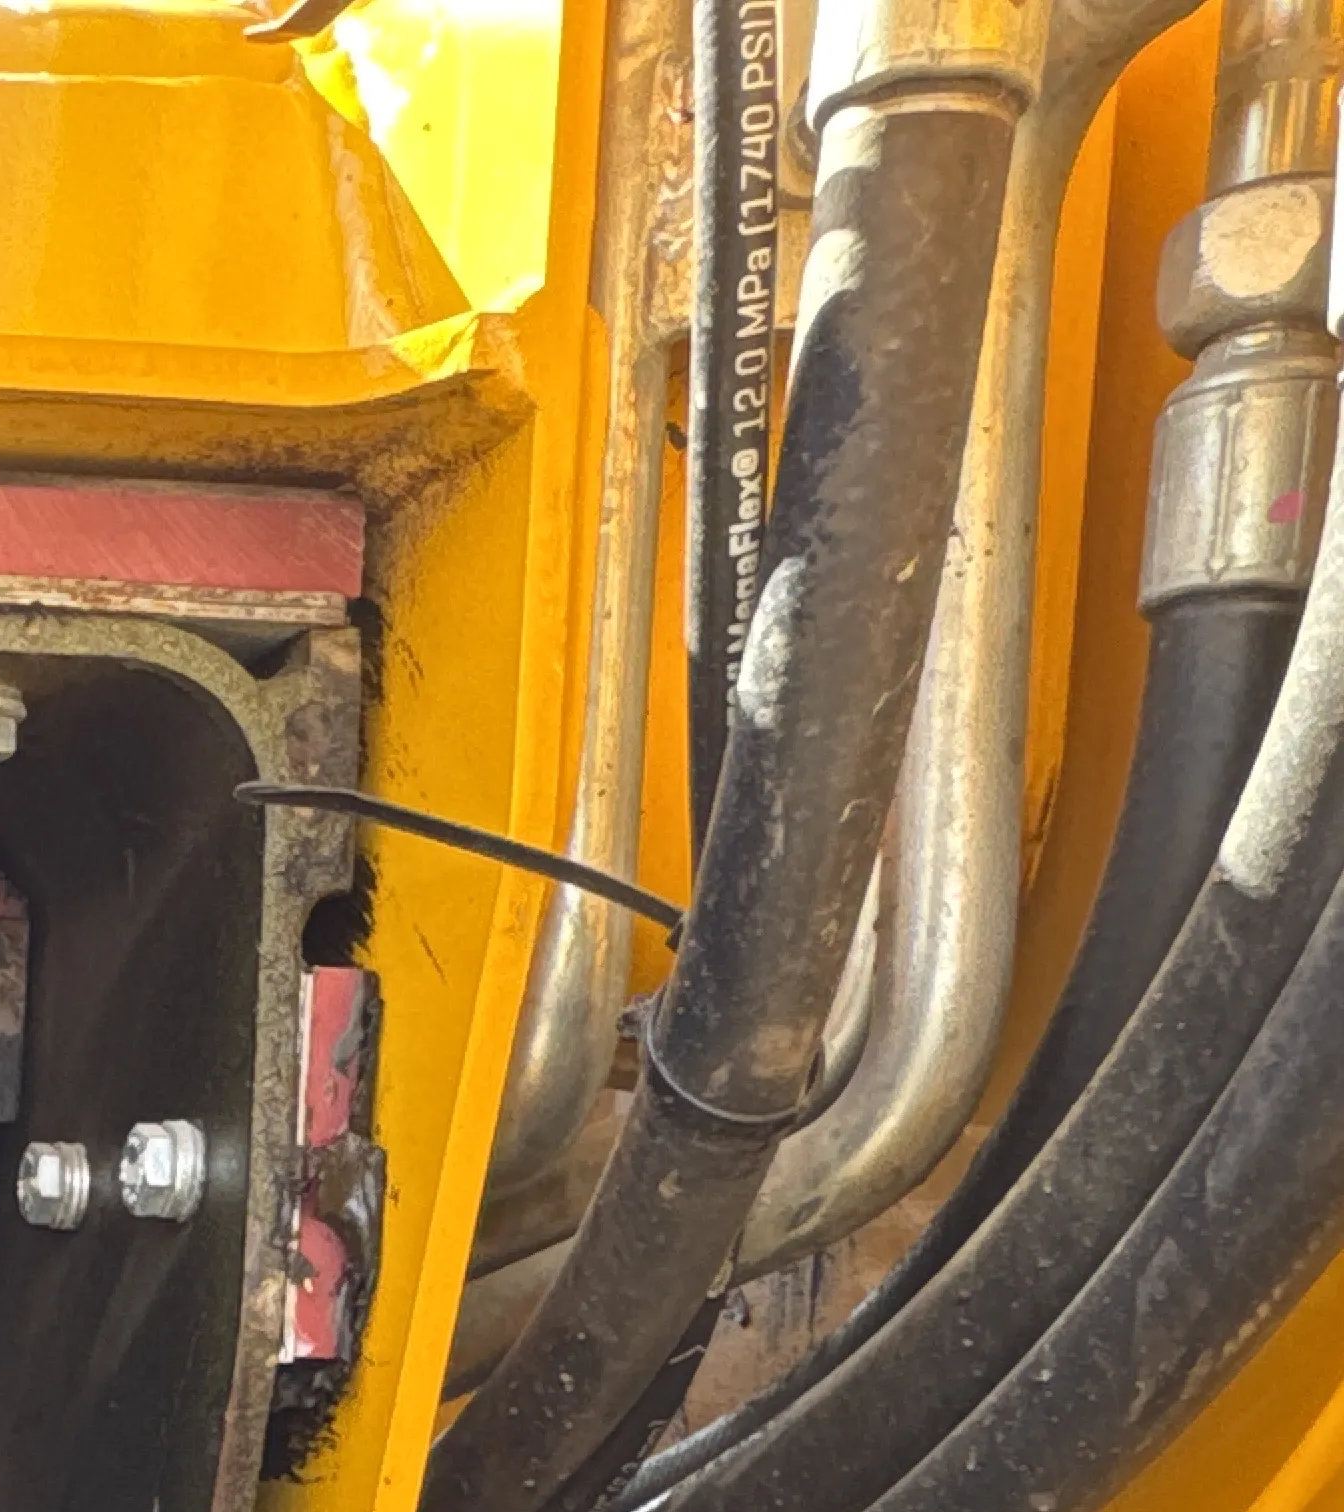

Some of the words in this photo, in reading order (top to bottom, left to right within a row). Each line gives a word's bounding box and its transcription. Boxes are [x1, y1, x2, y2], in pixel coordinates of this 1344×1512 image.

[738, 0, 778, 92] PSI)
[738, 102, 778, 236] (1740
[735, 246, 773, 339] MPa
[733, 347, 768, 438] 12.0
